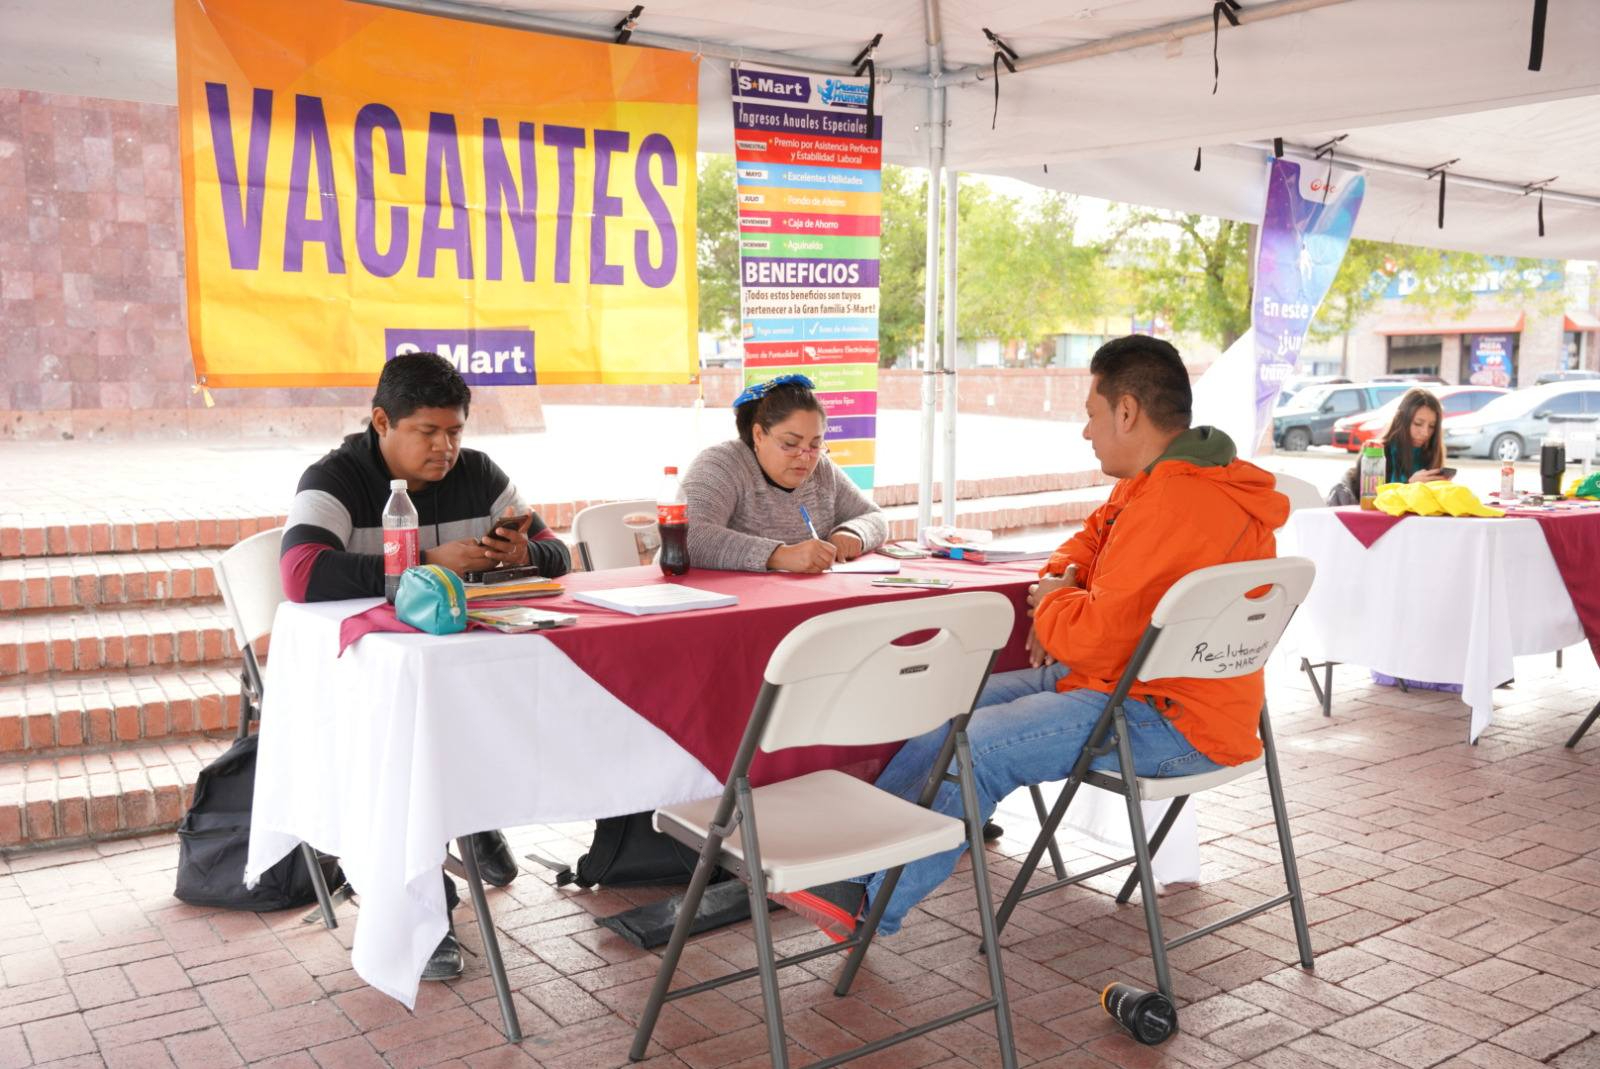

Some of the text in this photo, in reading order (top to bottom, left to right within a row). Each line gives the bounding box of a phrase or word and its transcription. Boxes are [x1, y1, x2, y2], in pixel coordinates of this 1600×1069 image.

[739, 108, 868, 134] Ingresos Anuales Especiales
[774, 137, 878, 154] Premio por Asistencia Perfecta
[797, 150, 834, 162] Estabilidad
[837, 152, 862, 164] Laboral
[204, 82, 678, 288] VACANTES
[788, 219, 839, 230] Caja de Ahorro
[788, 240, 823, 251] Aguinaldo
[745, 262, 860, 284] BENEFICIOS
[770, 291, 789, 300] estos
[790, 290, 827, 300] beneficios
[828, 292, 840, 300] son
[841, 291, 861, 302] tuyos
[746, 304, 786, 317] pertenecer
[788, 306, 792, 314] a
[794, 304, 800, 314] la
[802, 304, 818, 314] Gran
[820, 304, 845, 314] familia
[847, 304, 875, 314] S-Mart!
[1263, 297, 1279, 317] En
[1281, 300, 1308, 319] este
